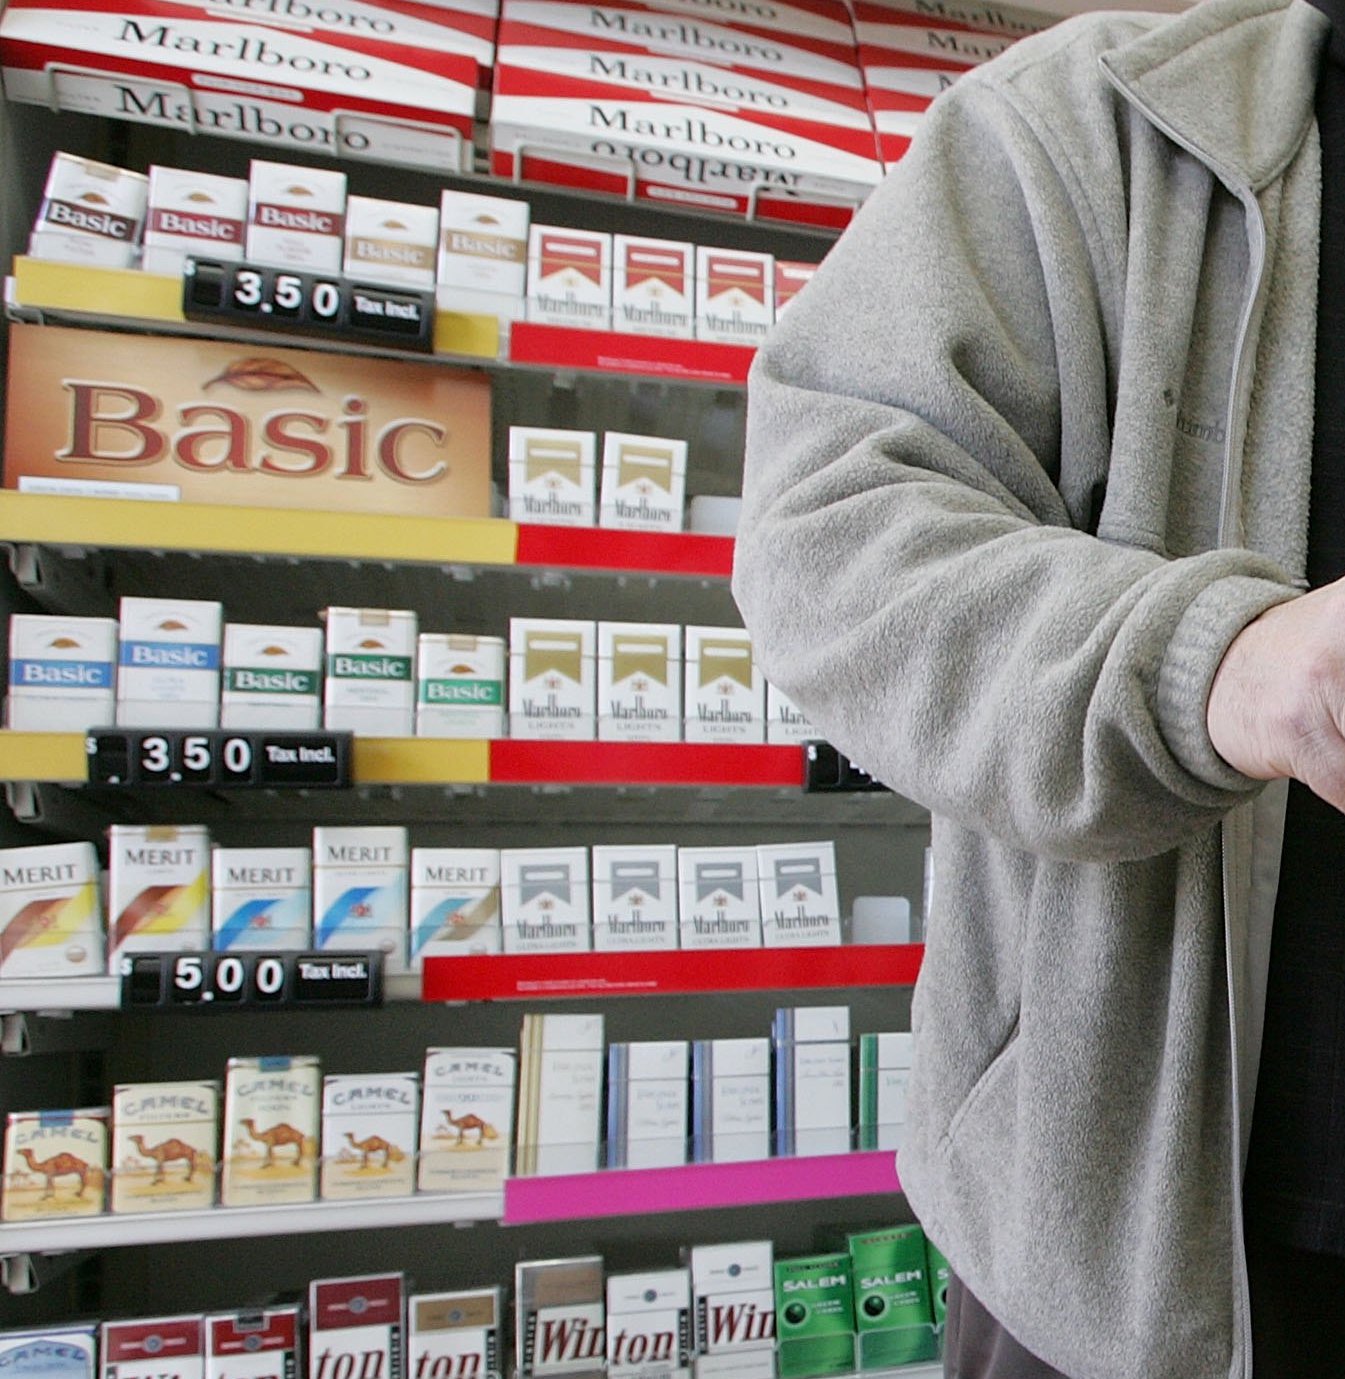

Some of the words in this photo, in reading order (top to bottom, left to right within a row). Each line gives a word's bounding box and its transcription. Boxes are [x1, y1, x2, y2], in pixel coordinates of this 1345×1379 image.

[588, 10, 783, 62] Marlboro
[115, 19, 371, 82] Marlboro
[588, 54, 789, 108] Marlboro
[115, 85, 369, 151] Marlboro
[586, 104, 797, 160] Marlboro
[47, 202, 128, 239] Basic
[160, 213, 235, 240] Basic
[260, 205, 332, 232] Basic
[356, 237, 424, 265] Basic
[452, 227, 516, 258] Basic
[235, 271, 339, 318] 3.50
[354, 294, 386, 314] Tax
[54, 377, 447, 484] Basic
[132, 644, 207, 667] Basic
[335, 656, 405, 679] Basic
[23, 661, 102, 685] Basic
[236, 670, 309, 693] Basic
[428, 682, 493, 701] Basic
[522, 694, 581, 718] Marlboro
[611, 695, 668, 720] Marlboro
[697, 699, 751, 723] Marlboro
[266, 744, 298, 763] Tax
[125, 848, 196, 868] MERIT
[327, 845, 391, 863] MERIT
[3, 864, 76, 884] MERIT
[227, 867, 295, 884] MERIT
[425, 866, 488, 883] MERIT
[517, 914, 576, 940] Marlboro
[608, 909, 665, 934] Marlboro
[693, 909, 749, 934] Marlboro
[775, 905, 829, 929] Marlboro
[175, 957, 283, 1002] 5.00
[301, 962, 331, 980] Tax
[435, 1061, 503, 1077] CAMEL
[236, 1078, 313, 1097] CAMEL
[333, 1086, 411, 1106] CAMEL
[123, 1095, 209, 1116] CAMEL
[15, 1128, 99, 1146] CAMEL
[783, 1275, 847, 1292] SALEM
[861, 1269, 922, 1289] SALEM
